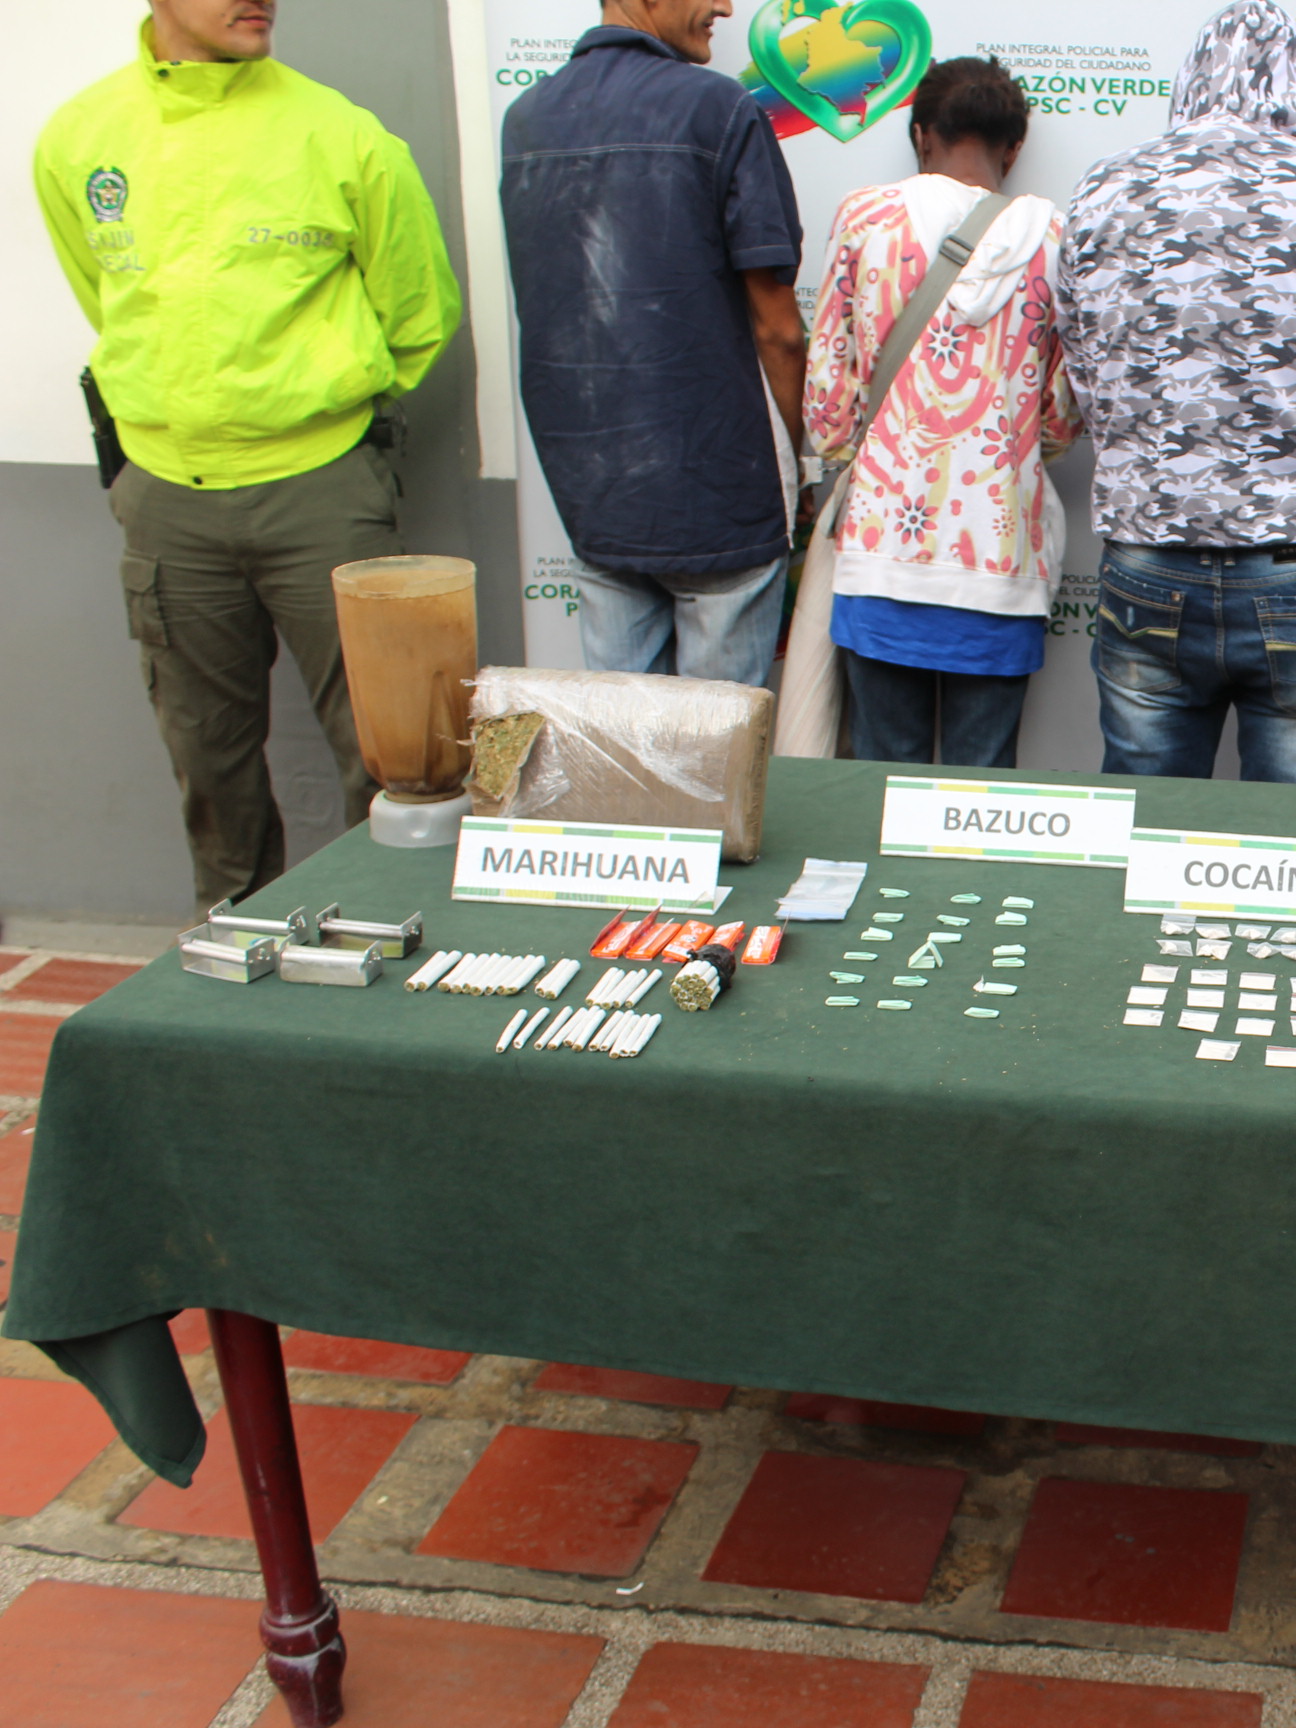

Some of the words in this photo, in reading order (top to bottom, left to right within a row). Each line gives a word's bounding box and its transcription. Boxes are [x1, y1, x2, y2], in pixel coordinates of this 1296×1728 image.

[510, 37, 541, 48] PLAN
[976, 43, 1006, 54] PLAN
[1009, 44, 1063, 56] INTEGRAL
[1067, 45, 1117, 57] POLICIAL
[1120, 47, 1149, 58] PARA
[506, 52, 521, 61] LA
[1056, 59, 1076, 69] DEL
[1080, 60, 1152, 72] CIUDADANO
[1091, 77, 1171, 97] VERDE
[1094, 98, 1128, 116] CV
[943, 806, 1071, 837] BAZUCO
[481, 846, 690, 884] MARIHUANA
